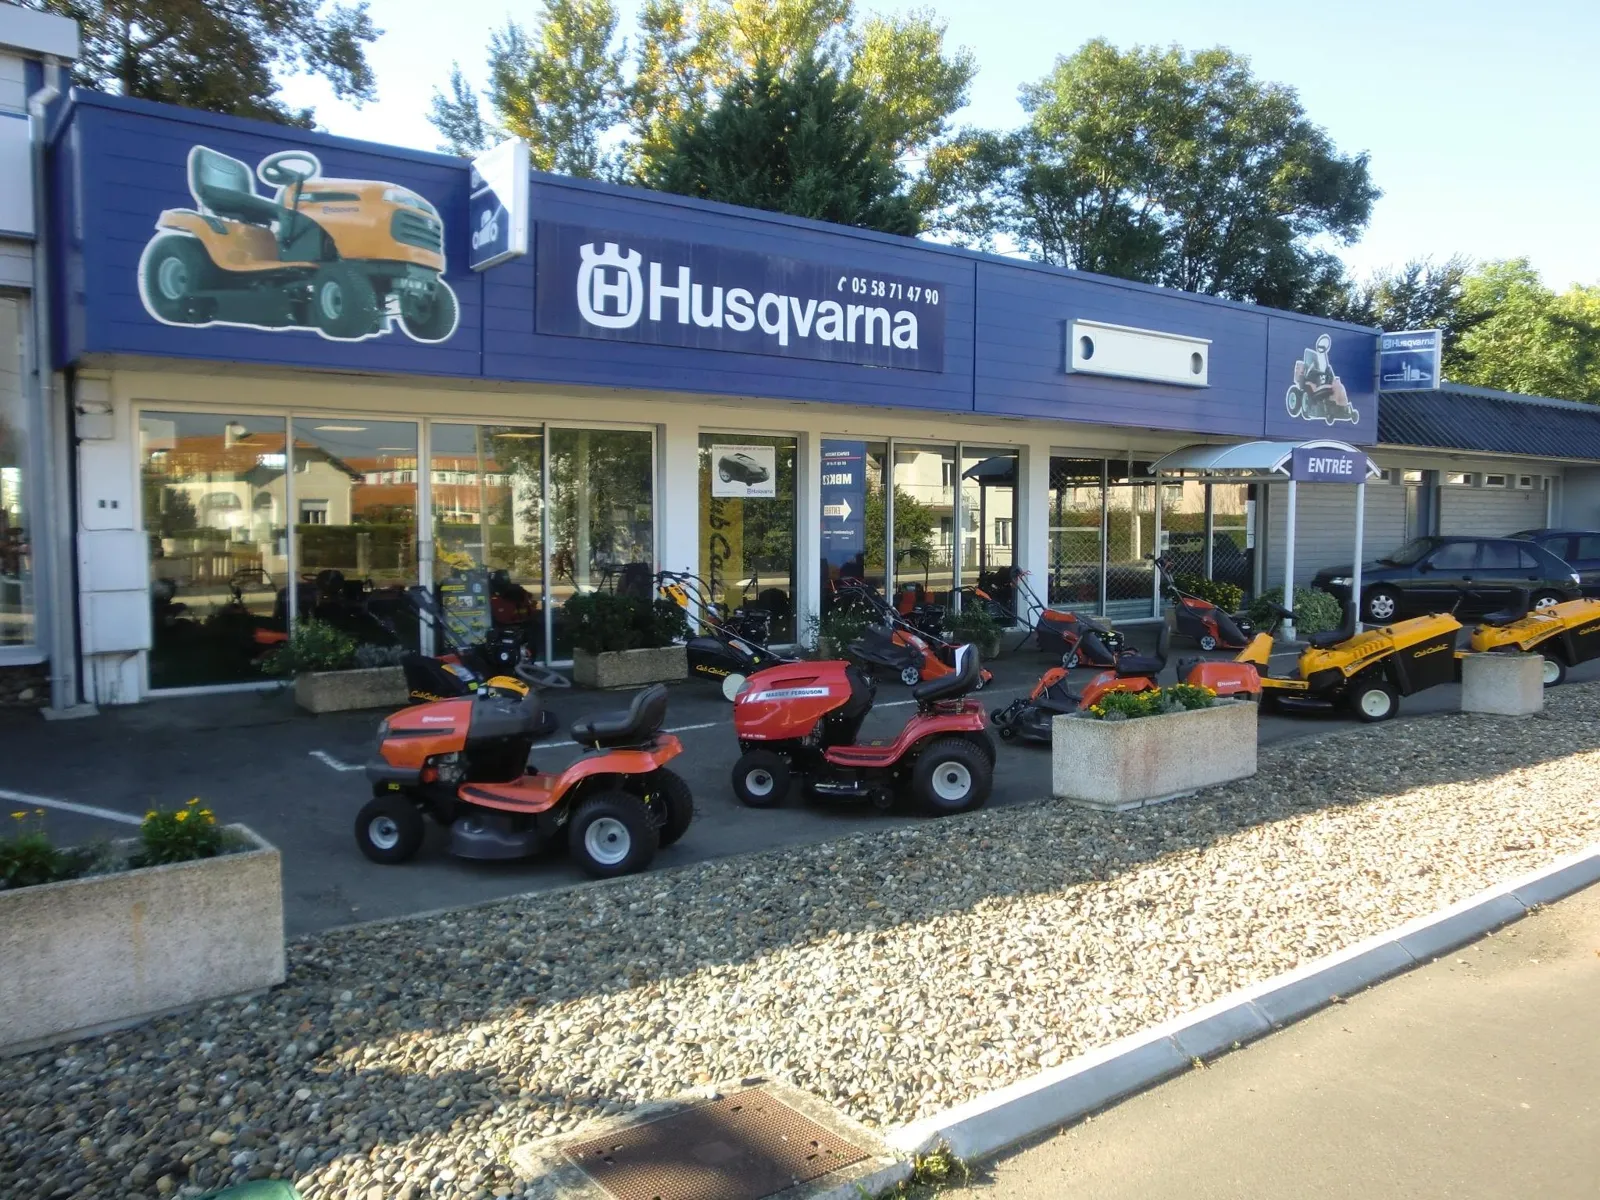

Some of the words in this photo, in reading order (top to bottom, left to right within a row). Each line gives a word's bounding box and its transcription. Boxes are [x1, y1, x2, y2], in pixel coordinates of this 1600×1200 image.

[852, 276, 867, 294] 05
[870, 279, 886, 297] 58
[889, 282, 903, 300] 71
[907, 285, 922, 302] 47
[925, 287, 940, 305] 90
[649, 261, 919, 350] Husqvarna
[1391, 338, 1435, 348] Husqvarna
[1307, 454, 1353, 475] ENTRÉE
[695, 664, 708, 672] Cub
[708, 667, 731, 677] Cadet
